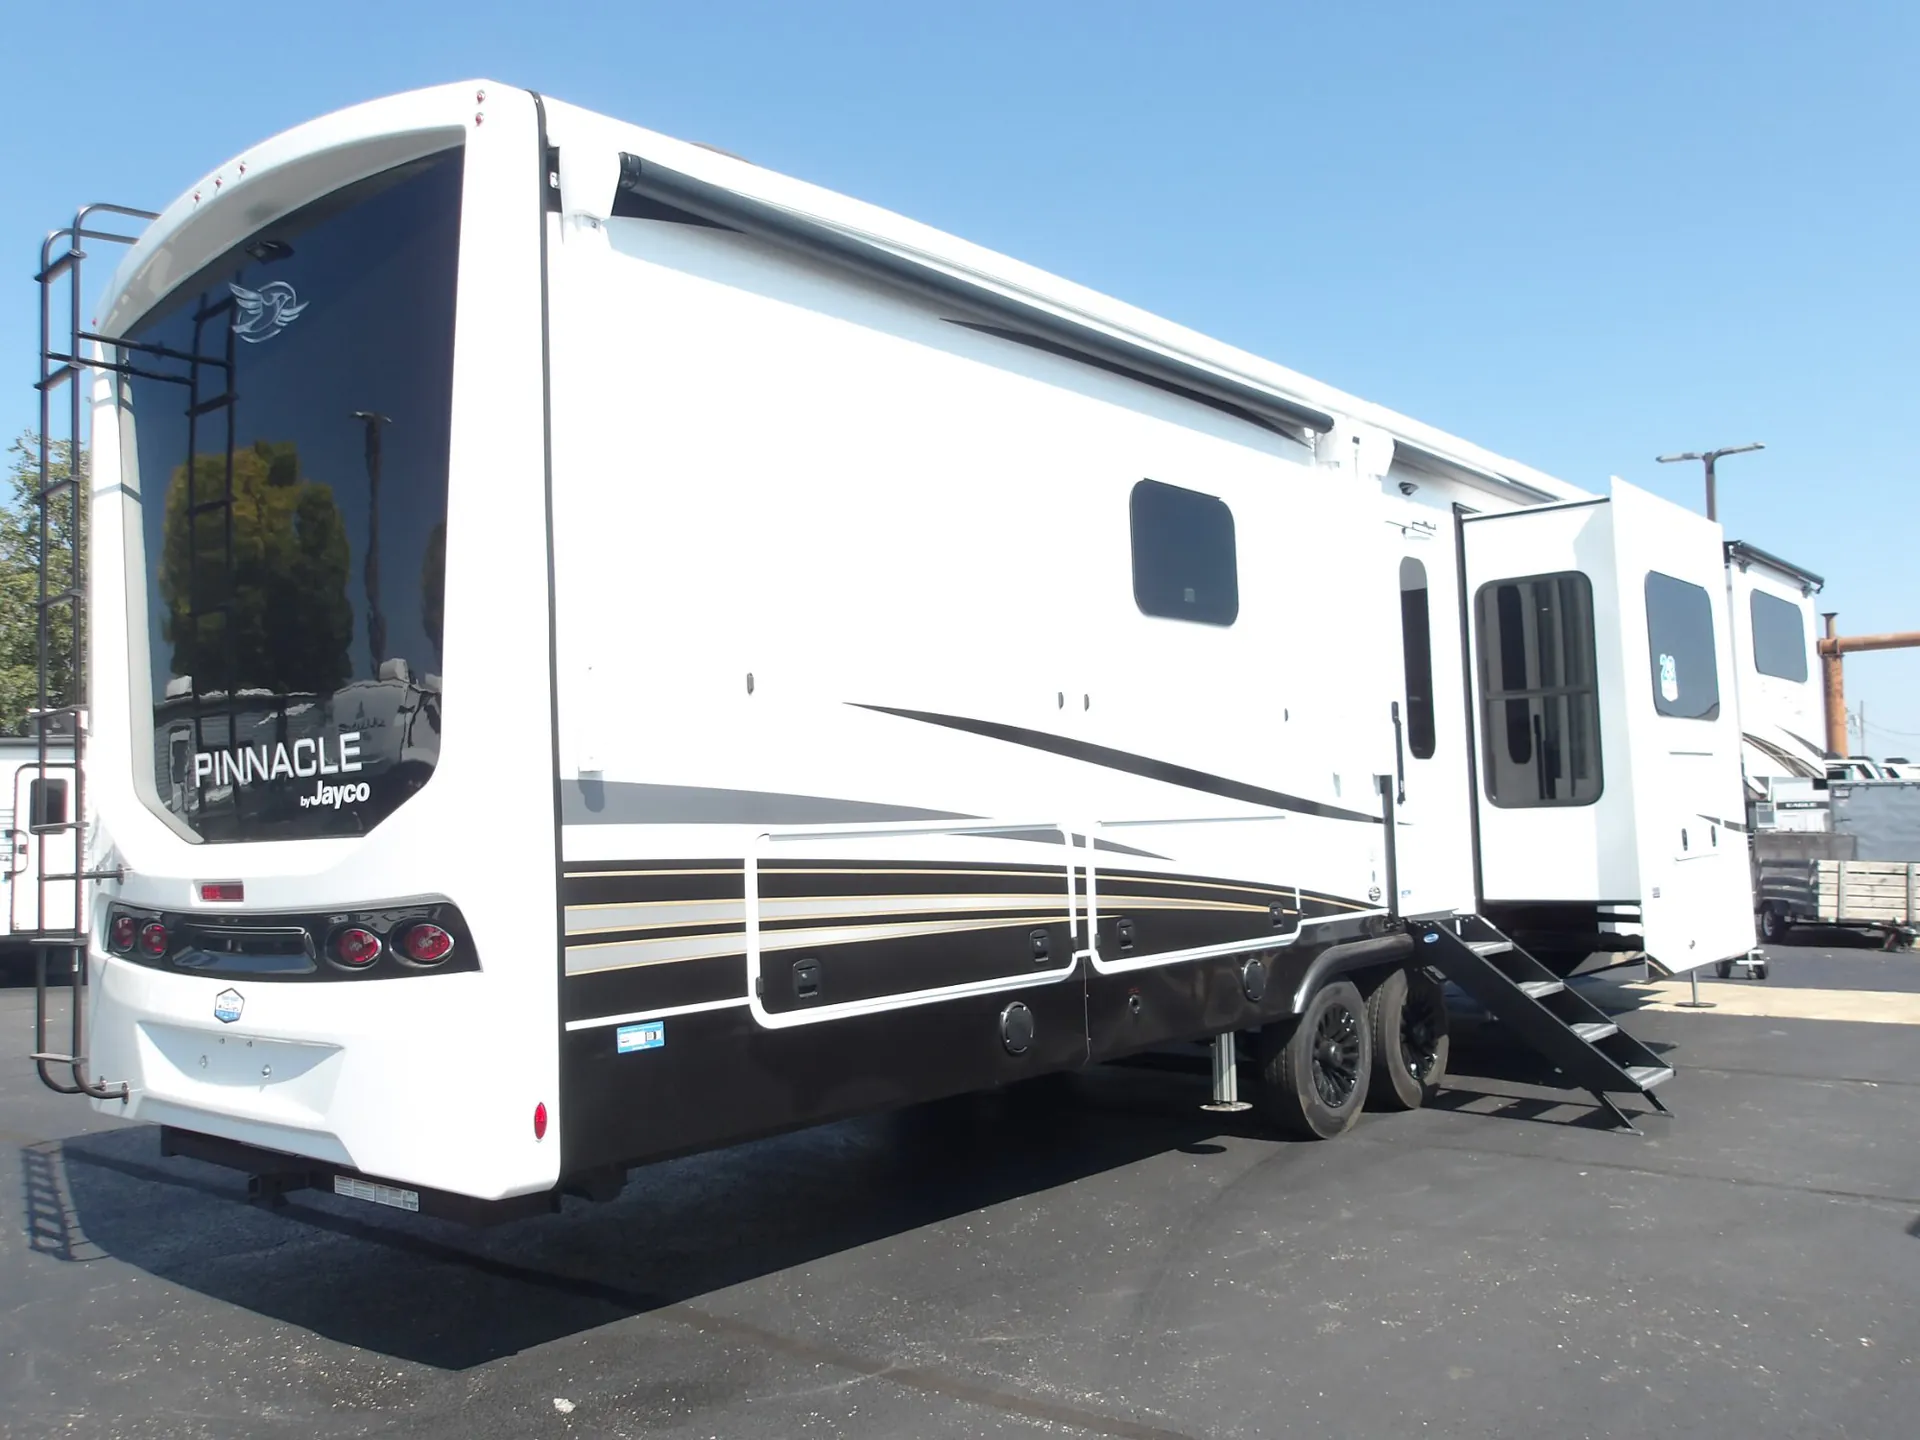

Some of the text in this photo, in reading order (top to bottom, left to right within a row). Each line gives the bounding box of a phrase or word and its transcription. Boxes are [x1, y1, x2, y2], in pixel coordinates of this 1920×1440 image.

[194, 731, 363, 788] PINNACLE
[300, 780, 371, 810] by Jayco
